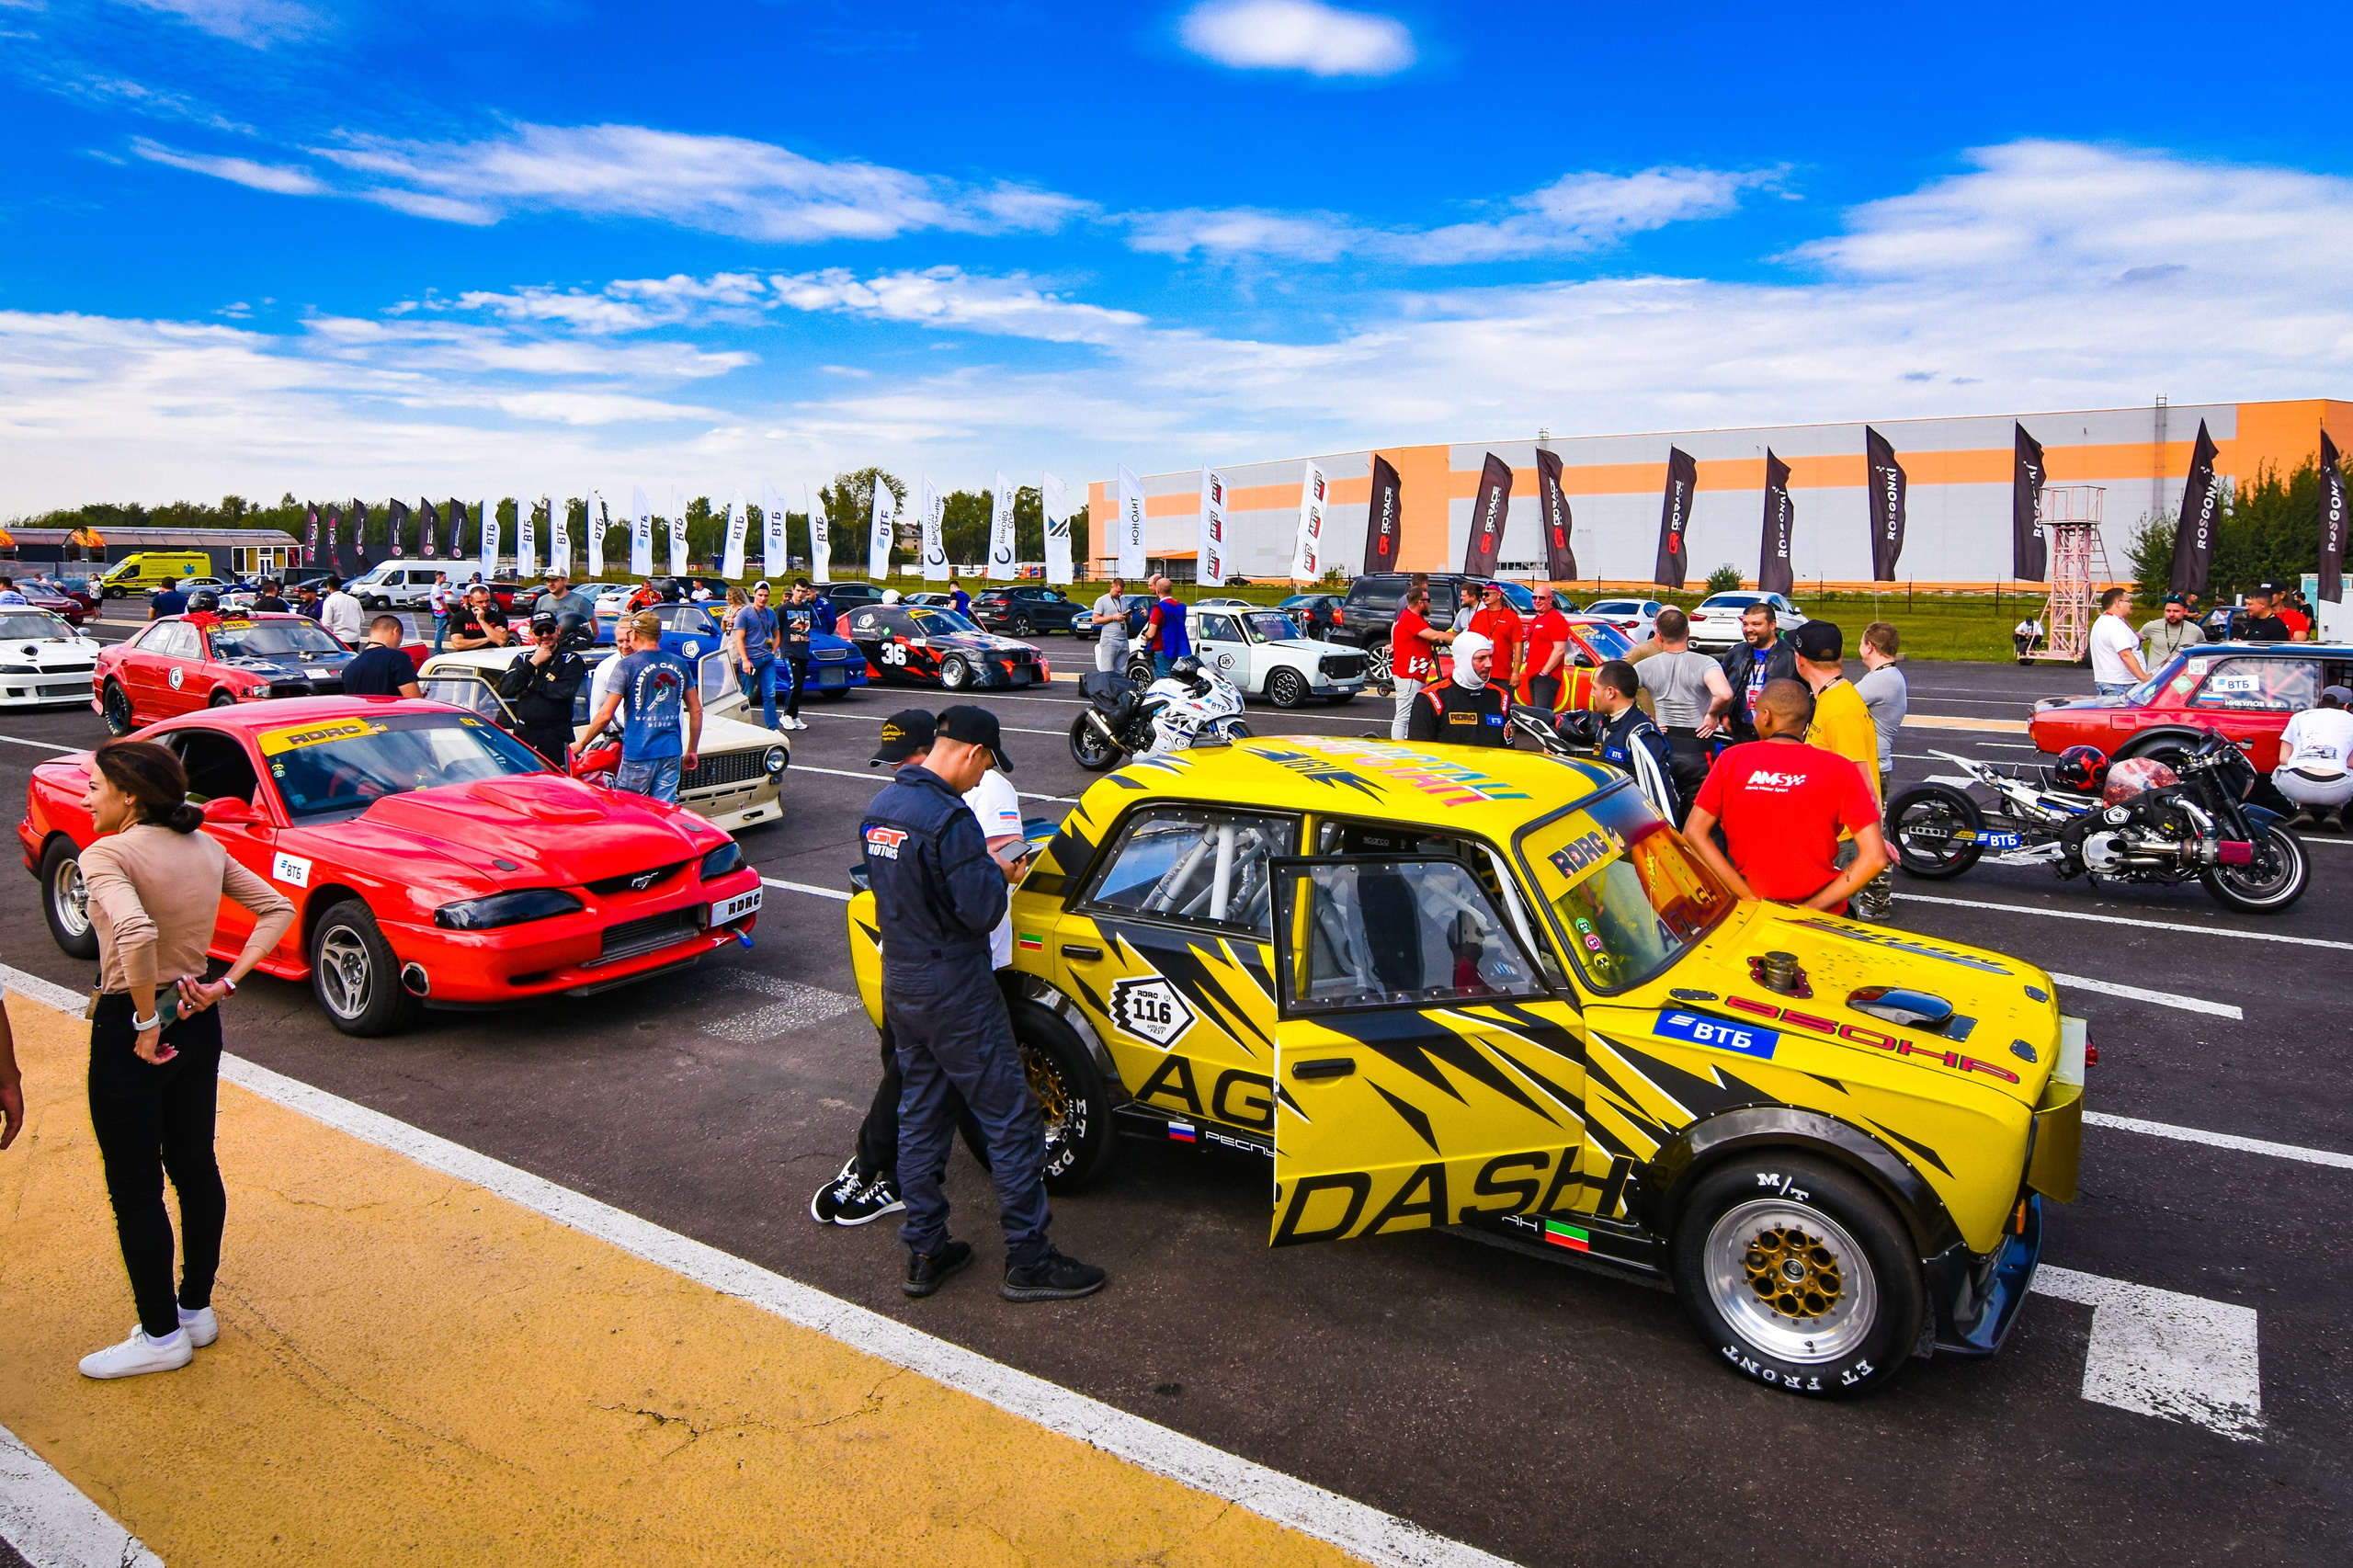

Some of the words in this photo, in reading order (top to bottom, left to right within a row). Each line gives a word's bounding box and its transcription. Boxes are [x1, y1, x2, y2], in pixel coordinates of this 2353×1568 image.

[1886, 467, 1897, 540] ROSGONKI
[2197, 472, 2217, 550] ROSGONK
[523, 520, 533, 542] ВТБ
[640, 515, 649, 538] ВТБ
[675, 517, 685, 541] ВТБ
[733, 516, 745, 540] ВТБ
[771, 511, 781, 537] ВТБ
[816, 516, 827, 542] ВТБ
[1131, 496, 1140, 545] МОНОЛИТ
[486, 524, 495, 546] ВТБ
[881, 642, 906, 666] 36
[635, 664, 656, 710] HOLLISTER
[2227, 680, 2250, 689] ВТБ
[1211, 702, 1226, 713] ВТБ
[2224, 699, 2265, 708] НИКУЛОВ
[286, 724, 362, 745] RDRC
[866, 826, 909, 847] GT
[1990, 835, 2018, 846] ВТБ
[867, 843, 899, 860] MOTORS
[1547, 830, 1610, 880] RDRC
[285, 863, 302, 881] ВТБ
[727, 892, 761, 918] RDRC
[1137, 989, 1159, 999] RDRC
[1132, 998, 1172, 1025] 116
[1692, 1021, 1752, 1049] ВТБ
[1269, 1145, 1635, 1248] DASH
[1756, 1173, 1810, 1202] M/T
[1722, 1345, 1824, 1391] FRONT
[1840, 1359, 1876, 1386] ET
